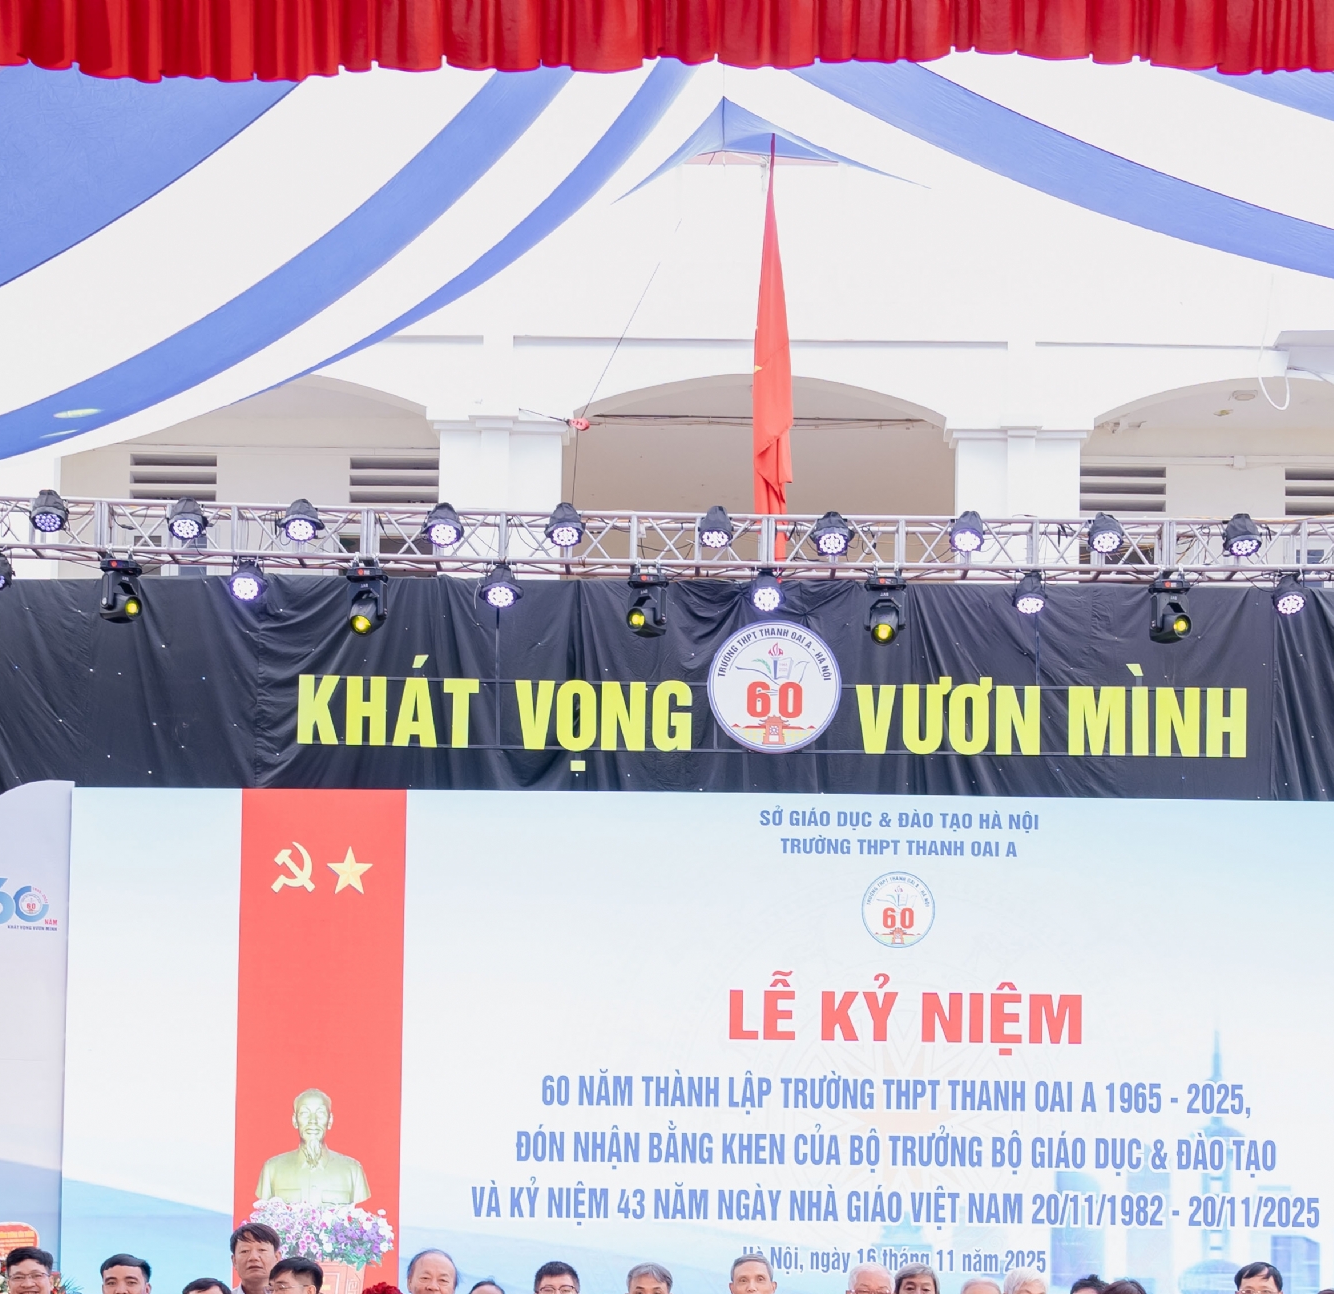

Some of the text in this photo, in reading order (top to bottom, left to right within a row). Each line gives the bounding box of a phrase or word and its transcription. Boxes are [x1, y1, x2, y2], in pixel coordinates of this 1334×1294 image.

[737, 632, 757, 647] THPT
[759, 628, 789, 637] THANH
[791, 632, 805, 643] OAI
[296, 654, 1247, 771] KHÁT VỌNG VƯƠN MÌNH
[747, 681, 802, 718] 60
[759, 805, 1039, 833] SỞ GIÁO DỤC & ĐÀO TẠO HÀ NỘI
[780, 836, 1017, 858] TRƯỜNG THPT THANH OAI A
[883, 907, 914, 929] 60
[729, 970, 1082, 1056] LỄ KỶ NIỆM
[541, 1074, 570, 1106] 60
[578, 1069, 633, 1107] NĂM
[642, 1069, 719, 1107] THÀNH
[728, 1070, 772, 1115] LẬP
[780, 1070, 875, 1110] TRƯỜNG
[883, 1079, 940, 1110] THPT
[948, 1080, 1026, 1112] THANH
[1035, 1082, 1073, 1113] OAI
[1081, 1082, 1096, 1113] A
[1105, 1082, 1162, 1114] 1965
[1186, 1083, 1251, 1118] 2025,
[516, 1121, 1277, 1178] ĐÓN NHẬN BẰNG KHEN CỦA BỘ TRƯỞNG BỘ GIÁO DỤC & ĐÀO TẠO
[471, 1180, 501, 1218] VÀ
[510, 1176, 539, 1218] KỶ
[547, 1180, 609, 1225] NIỆM
[617, 1188, 646, 1219] 43
[654, 1182, 708, 1220] NĂM
[717, 1183, 781, 1221] NGÀY
[789, 1184, 838, 1222] NHÀ
[847, 1183, 902, 1222] GIÁO
[910, 1185, 960, 1230] VIỆT
[967, 1192, 1023, 1225] NAM
[1031, 1193, 1163, 1227] 20/11/1982
[1188, 1195, 1320, 1228] 20/11/2025
[771, 1246, 803, 1274] Nội,
[810, 1247, 850, 1273] ngày
[857, 1249, 876, 1264] 16
[937, 1250, 953, 1271] 11
[963, 1249, 998, 1272] năm
[1005, 1250, 1046, 1273] 2025
